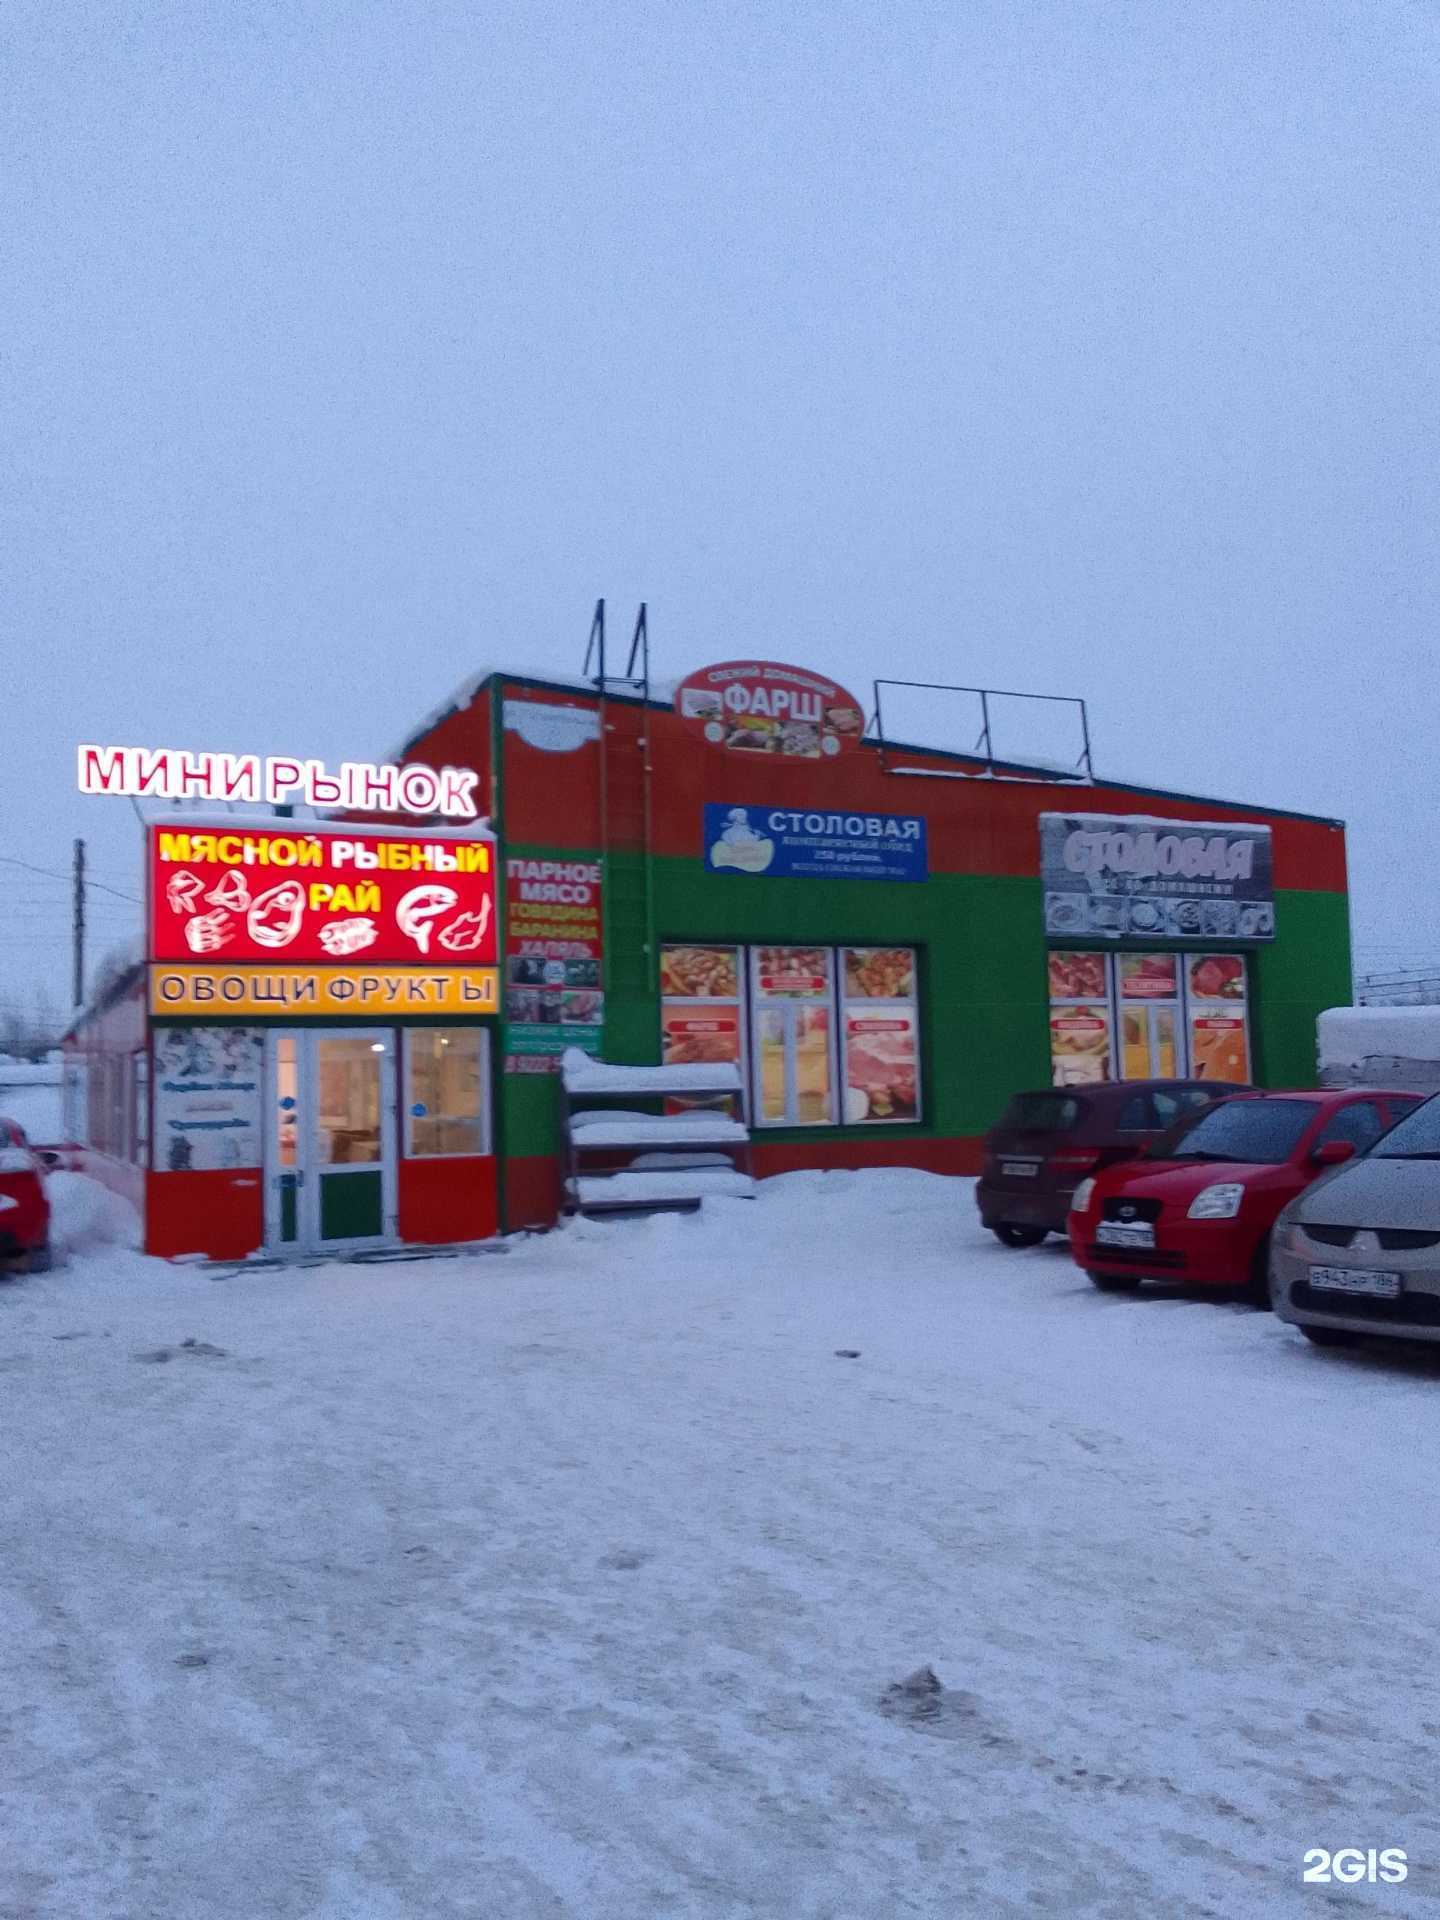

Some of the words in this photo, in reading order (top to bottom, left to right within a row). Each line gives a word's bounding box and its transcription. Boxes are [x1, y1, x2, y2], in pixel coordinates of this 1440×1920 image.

[724, 683, 822, 722] ФАРШ
[78, 744, 260, 802] МИНИ
[265, 756, 480, 818] РЫНОК
[768, 812, 920, 840] СТОЛОВАЯ
[158, 832, 323, 868] МЯСНОЙ
[331, 840, 490, 874] РЫБНЫЙ
[506, 860, 602, 884] ПАРНОЕ
[309, 880, 382, 913] РАЙ
[520, 882, 592, 904] МЯСО
[160, 974, 317, 1007] ОВОЩИ
